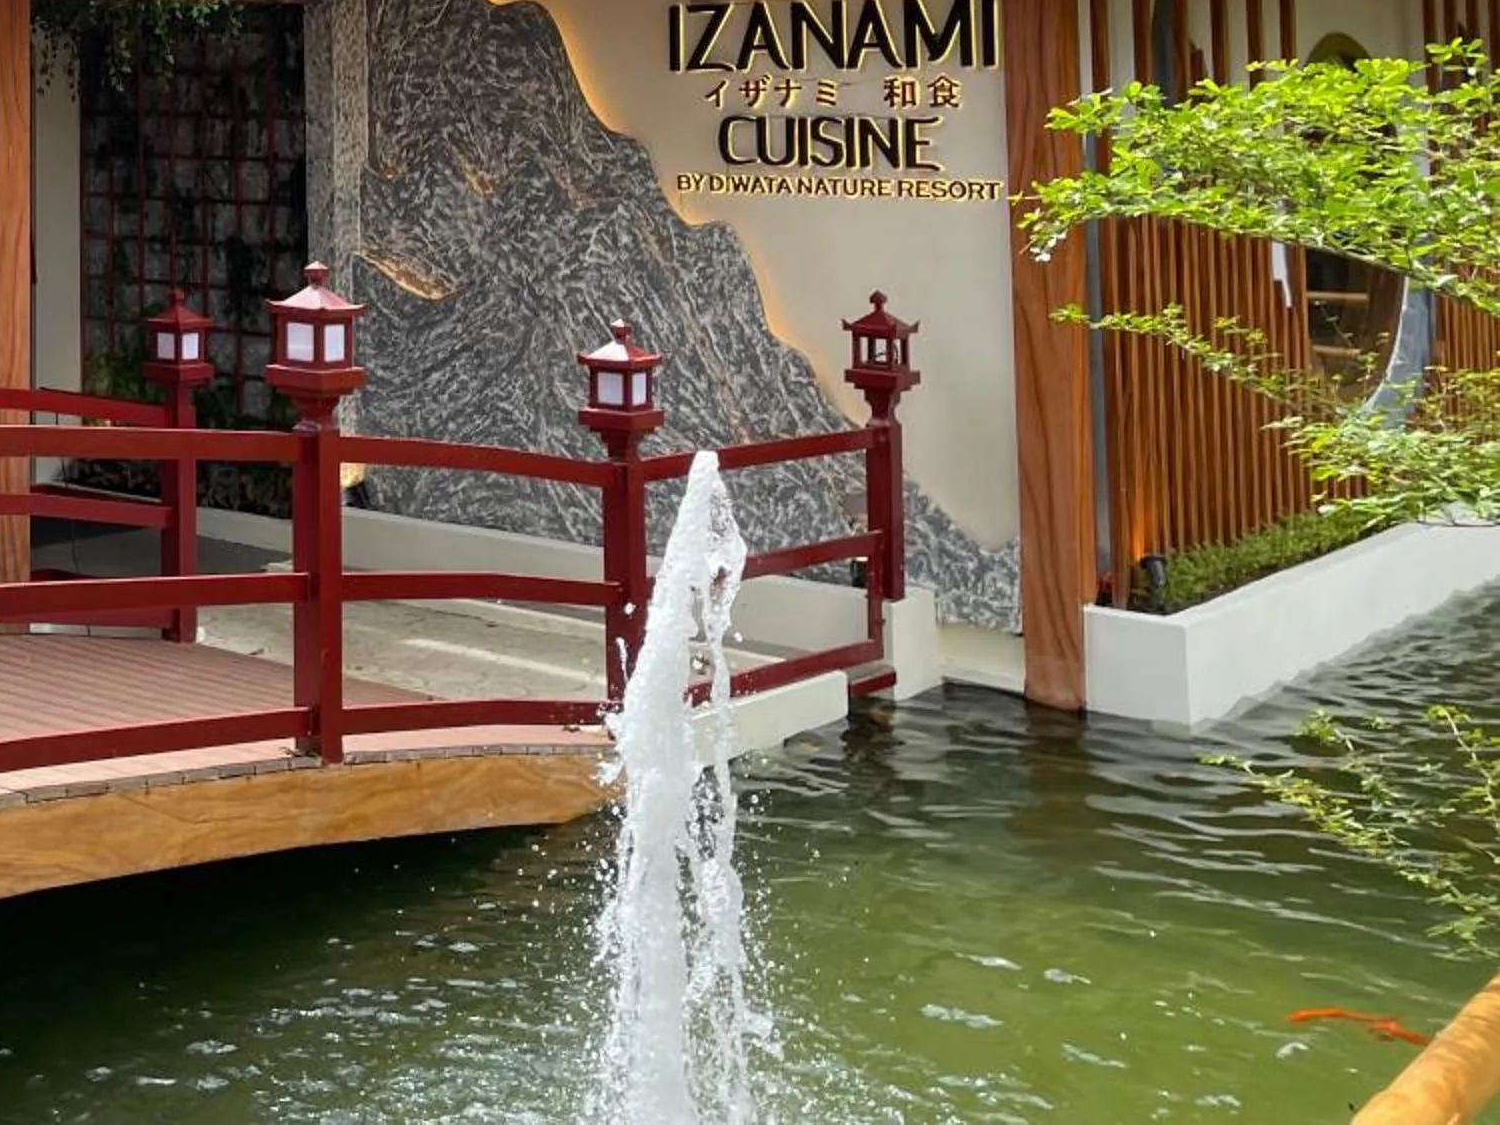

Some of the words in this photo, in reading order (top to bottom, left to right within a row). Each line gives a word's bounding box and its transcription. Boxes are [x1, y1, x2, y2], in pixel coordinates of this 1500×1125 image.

[705, 75, 839, 108] イザナミ
[884, 76, 962, 109] 和食
[718, 115, 943, 171] CUISINE
[677, 174, 704, 192] BY
[709, 175, 792, 194] DIWATA
[797, 178, 893, 198] NATURE
[898, 180, 1001, 201] RESORT
